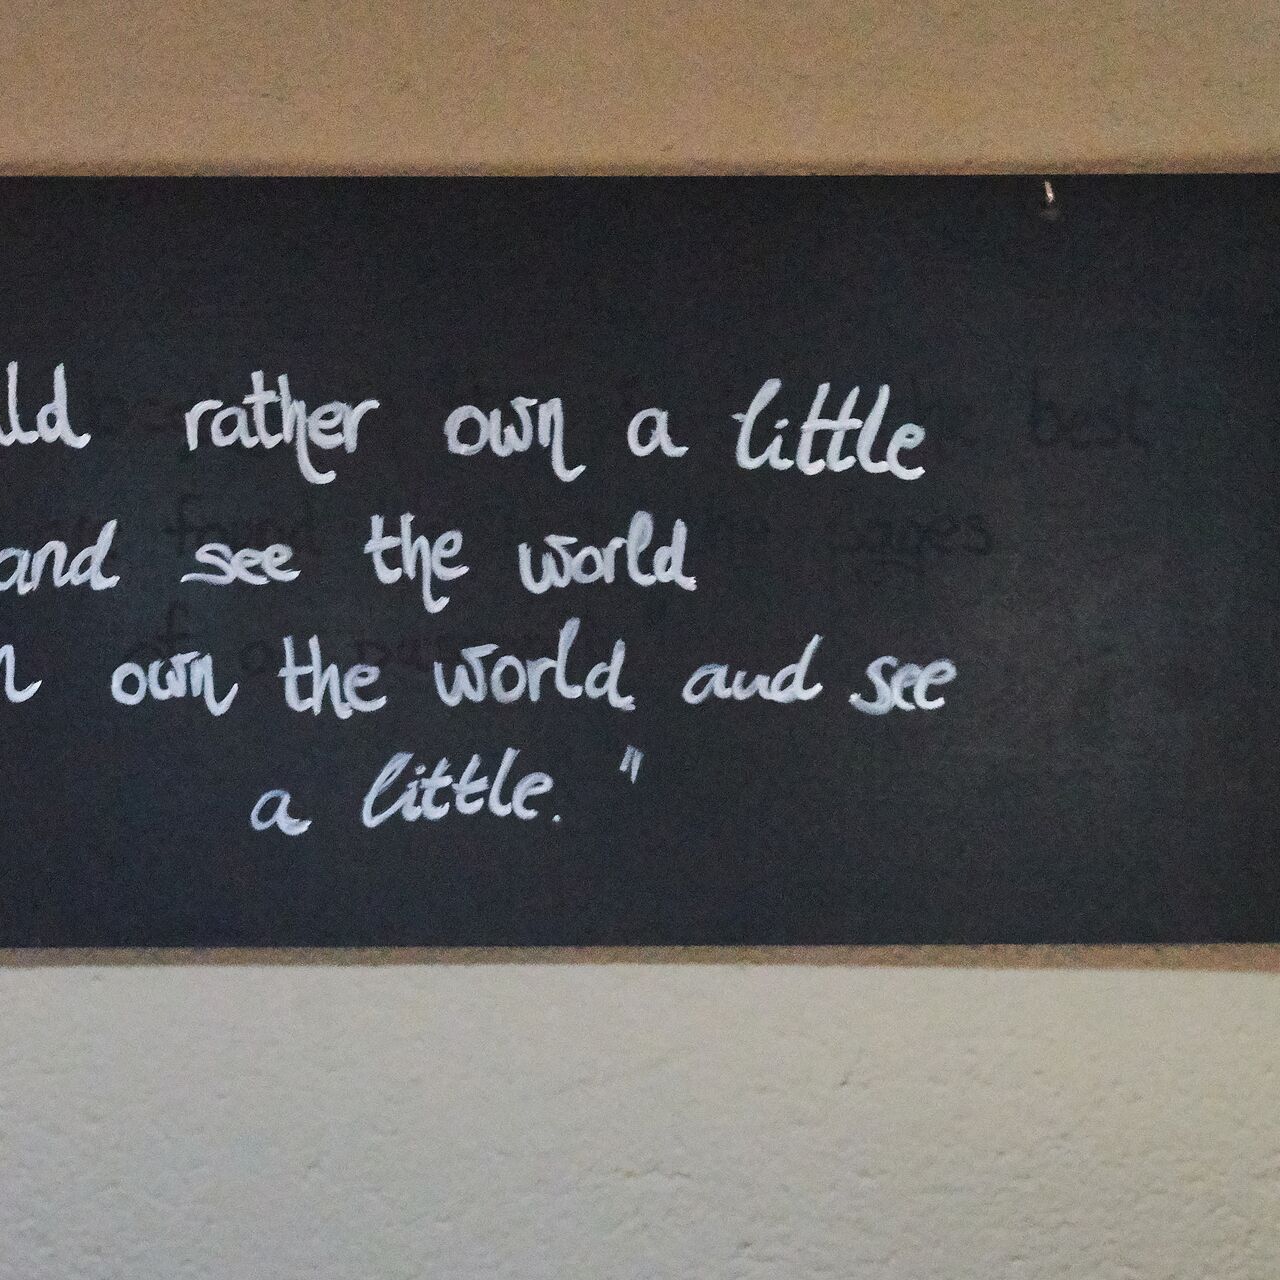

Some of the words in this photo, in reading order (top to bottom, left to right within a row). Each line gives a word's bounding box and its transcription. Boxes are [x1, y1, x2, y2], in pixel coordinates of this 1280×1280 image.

[183, 368, 382, 486] rather
[442, 395, 588, 484] own
[625, 406, 691, 459] a
[730, 376, 927, 482] little
[178, 541, 303, 587] see
[362, 511, 471, 615] the
[516, 509, 699, 596] world
[109, 649, 240, 718] own
[276, 633, 389, 721] the
[432, 616, 637, 712] world
[680, 632, 825, 706] and
[846, 654, 959, 717] see
[249, 788, 314, 838] a
